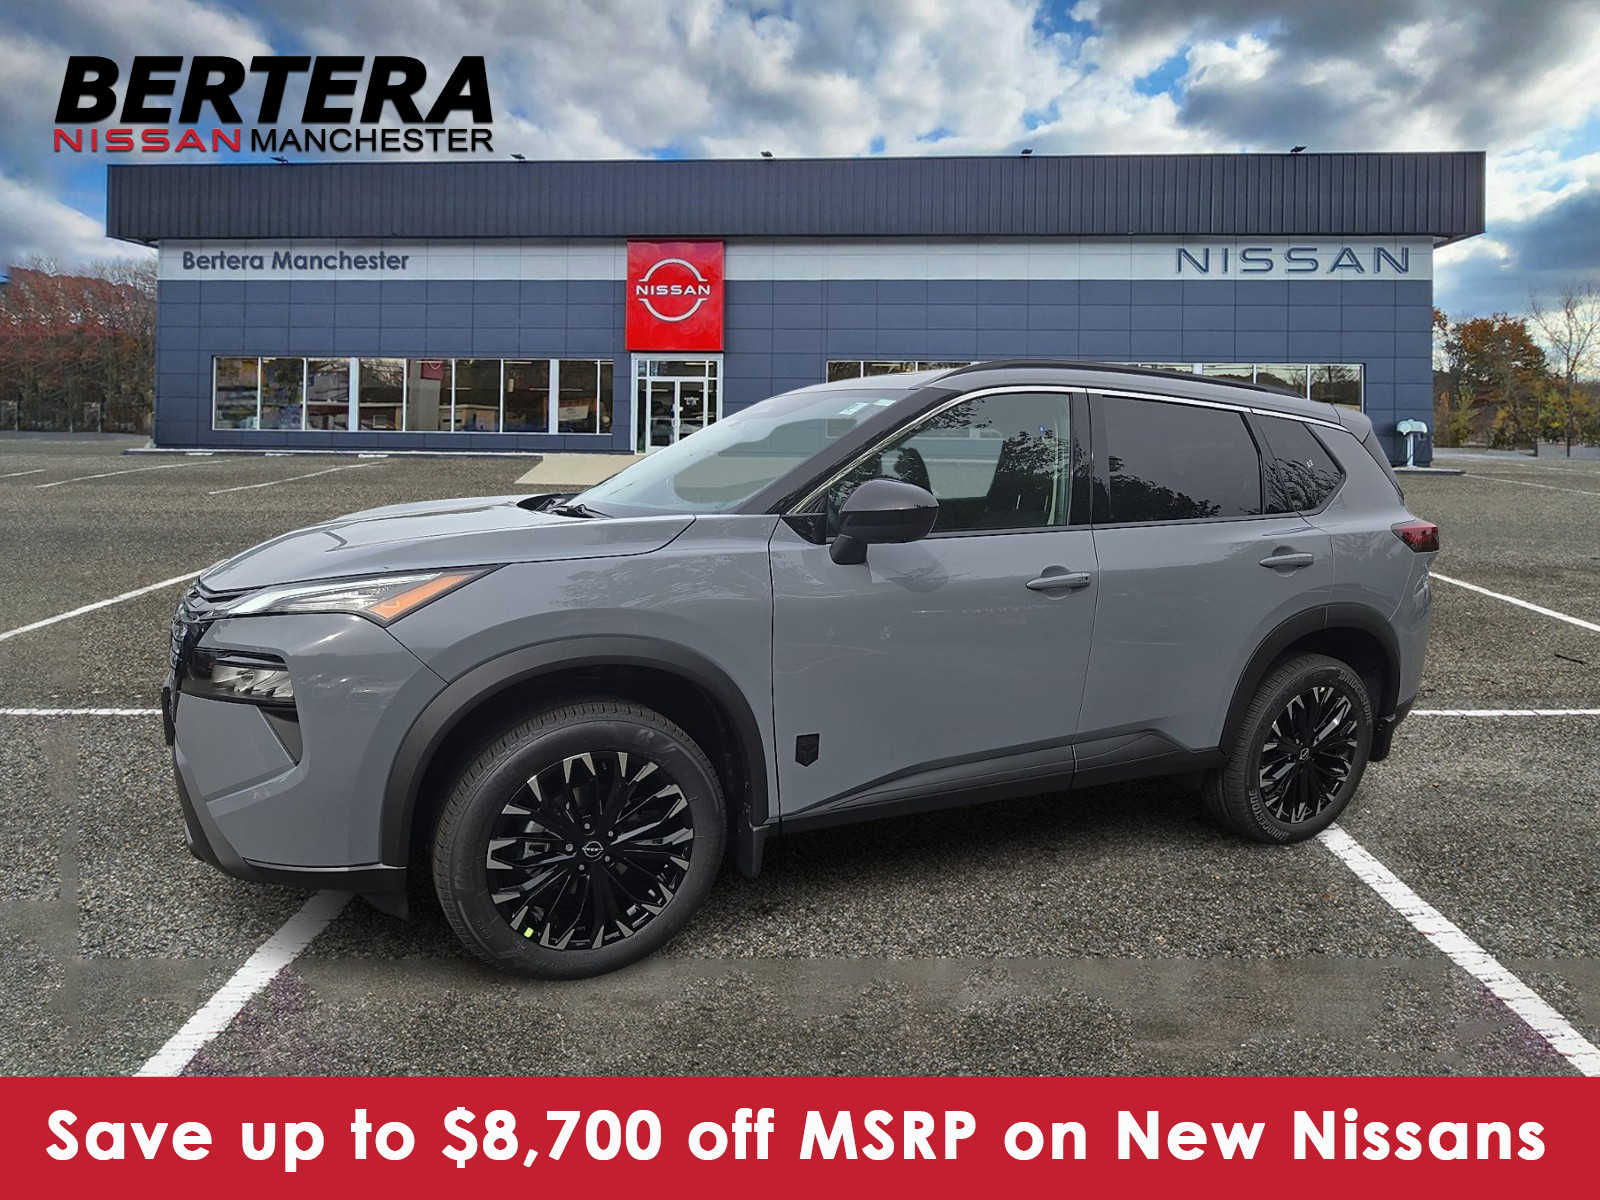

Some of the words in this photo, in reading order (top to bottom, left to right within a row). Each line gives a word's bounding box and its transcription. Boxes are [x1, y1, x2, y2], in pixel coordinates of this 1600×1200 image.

[182, 250, 264, 271] Bertera
[272, 249, 410, 271] Manchester
[1176, 247, 1409, 273] NISSAN
[636, 285, 711, 295] NISSAN
